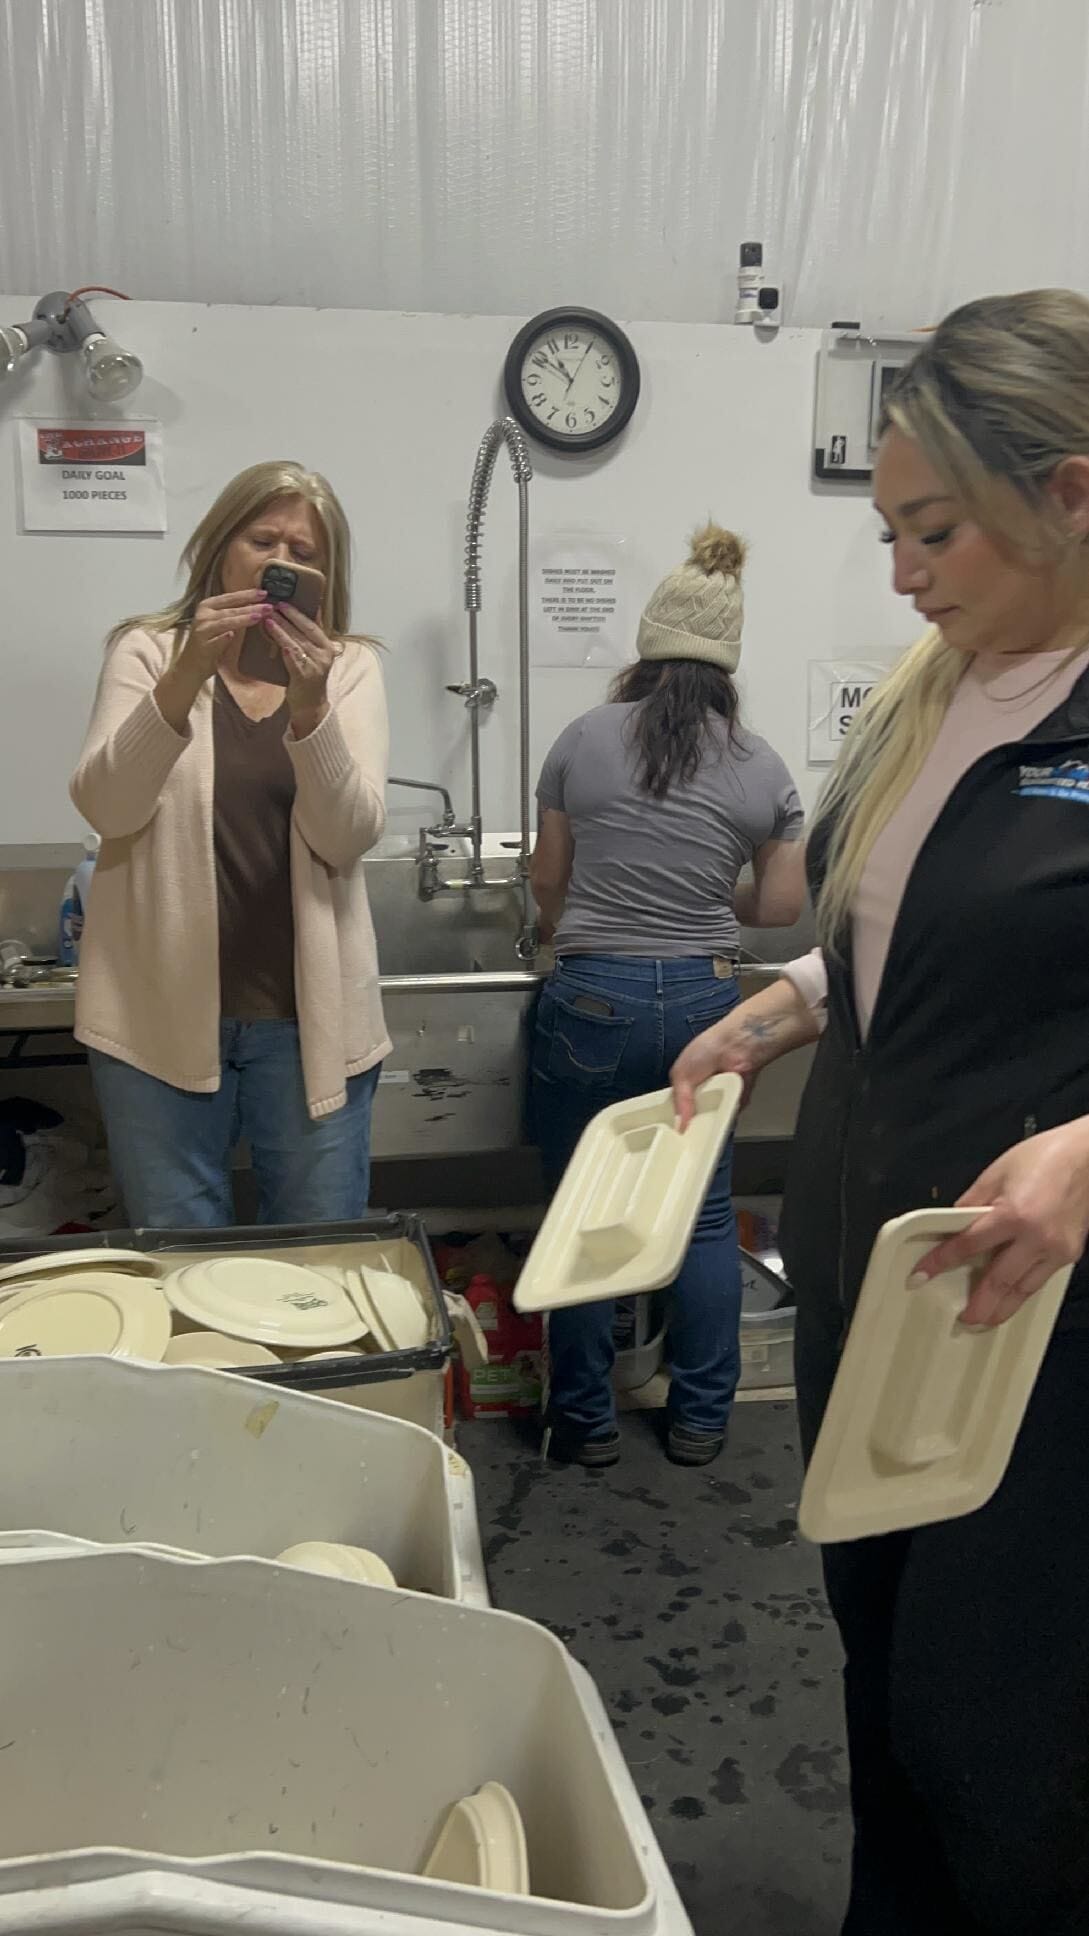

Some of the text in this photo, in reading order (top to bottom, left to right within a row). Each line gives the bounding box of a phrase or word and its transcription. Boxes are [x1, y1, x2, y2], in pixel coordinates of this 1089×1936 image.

[546, 338, 560, 355] 11
[564, 333, 579, 350] 12
[531, 350, 549, 370] 10
[526, 373, 541, 386] 9
[600, 375, 615, 388] 3
[531, 392, 548, 407] 8
[546, 405, 560, 420] 7
[564, 411, 577, 429] 6
[583, 407, 596, 424] 5
[61, 470, 126, 481] DAILY GOAL
[62, 490, 128, 501] 1000 PIECES
